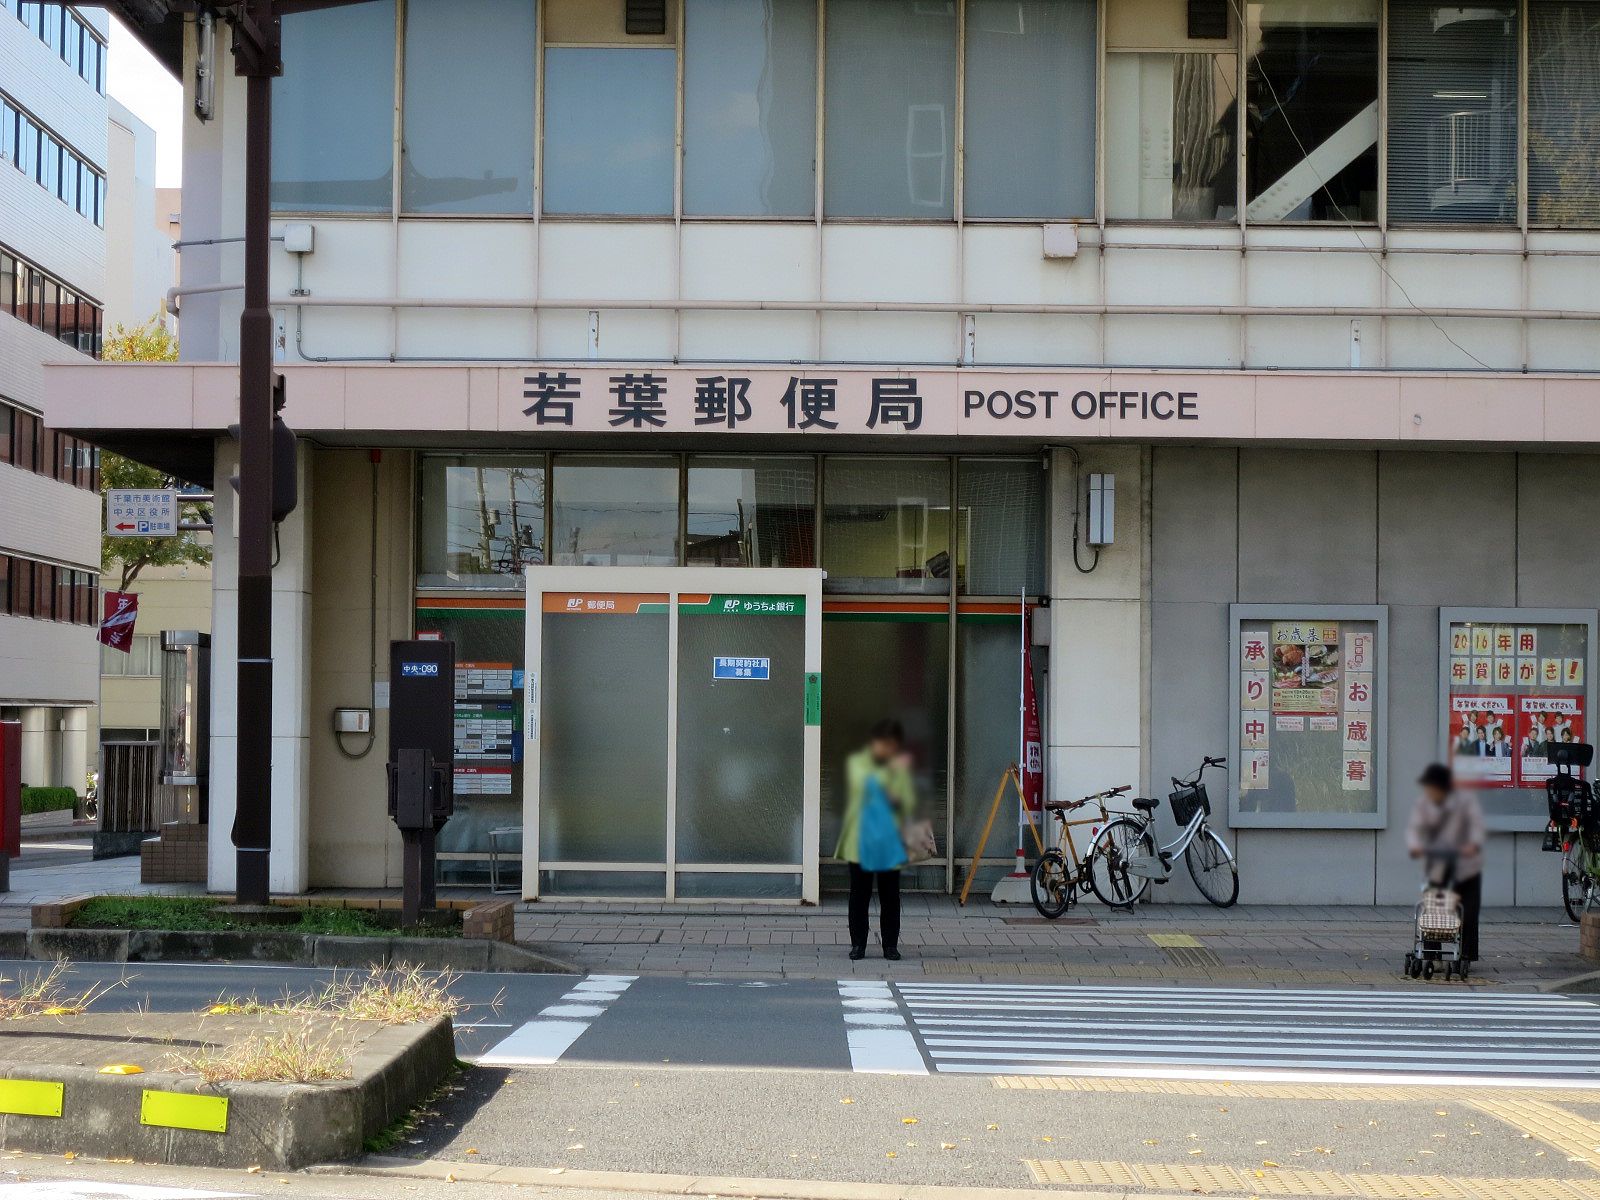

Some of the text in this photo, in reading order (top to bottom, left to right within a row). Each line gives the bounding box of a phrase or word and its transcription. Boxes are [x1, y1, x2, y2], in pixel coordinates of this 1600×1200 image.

[522, 371, 924, 431] 若葉郵便局
[964, 389, 1199, 421] POST OFFICE
[113, 494, 171, 503] 千葉市美術館
[113, 507, 171, 517] 中央区役所
[587, 600, 615, 610] 郵便局
[744, 602, 795, 612] ゆうちょ銀行
[1454, 634, 1534, 652] 2016年用
[719, 659, 768, 668] 長期契約社員
[735, 668, 752, 677] 募集
[1346, 681, 1369, 782] お歳暮
